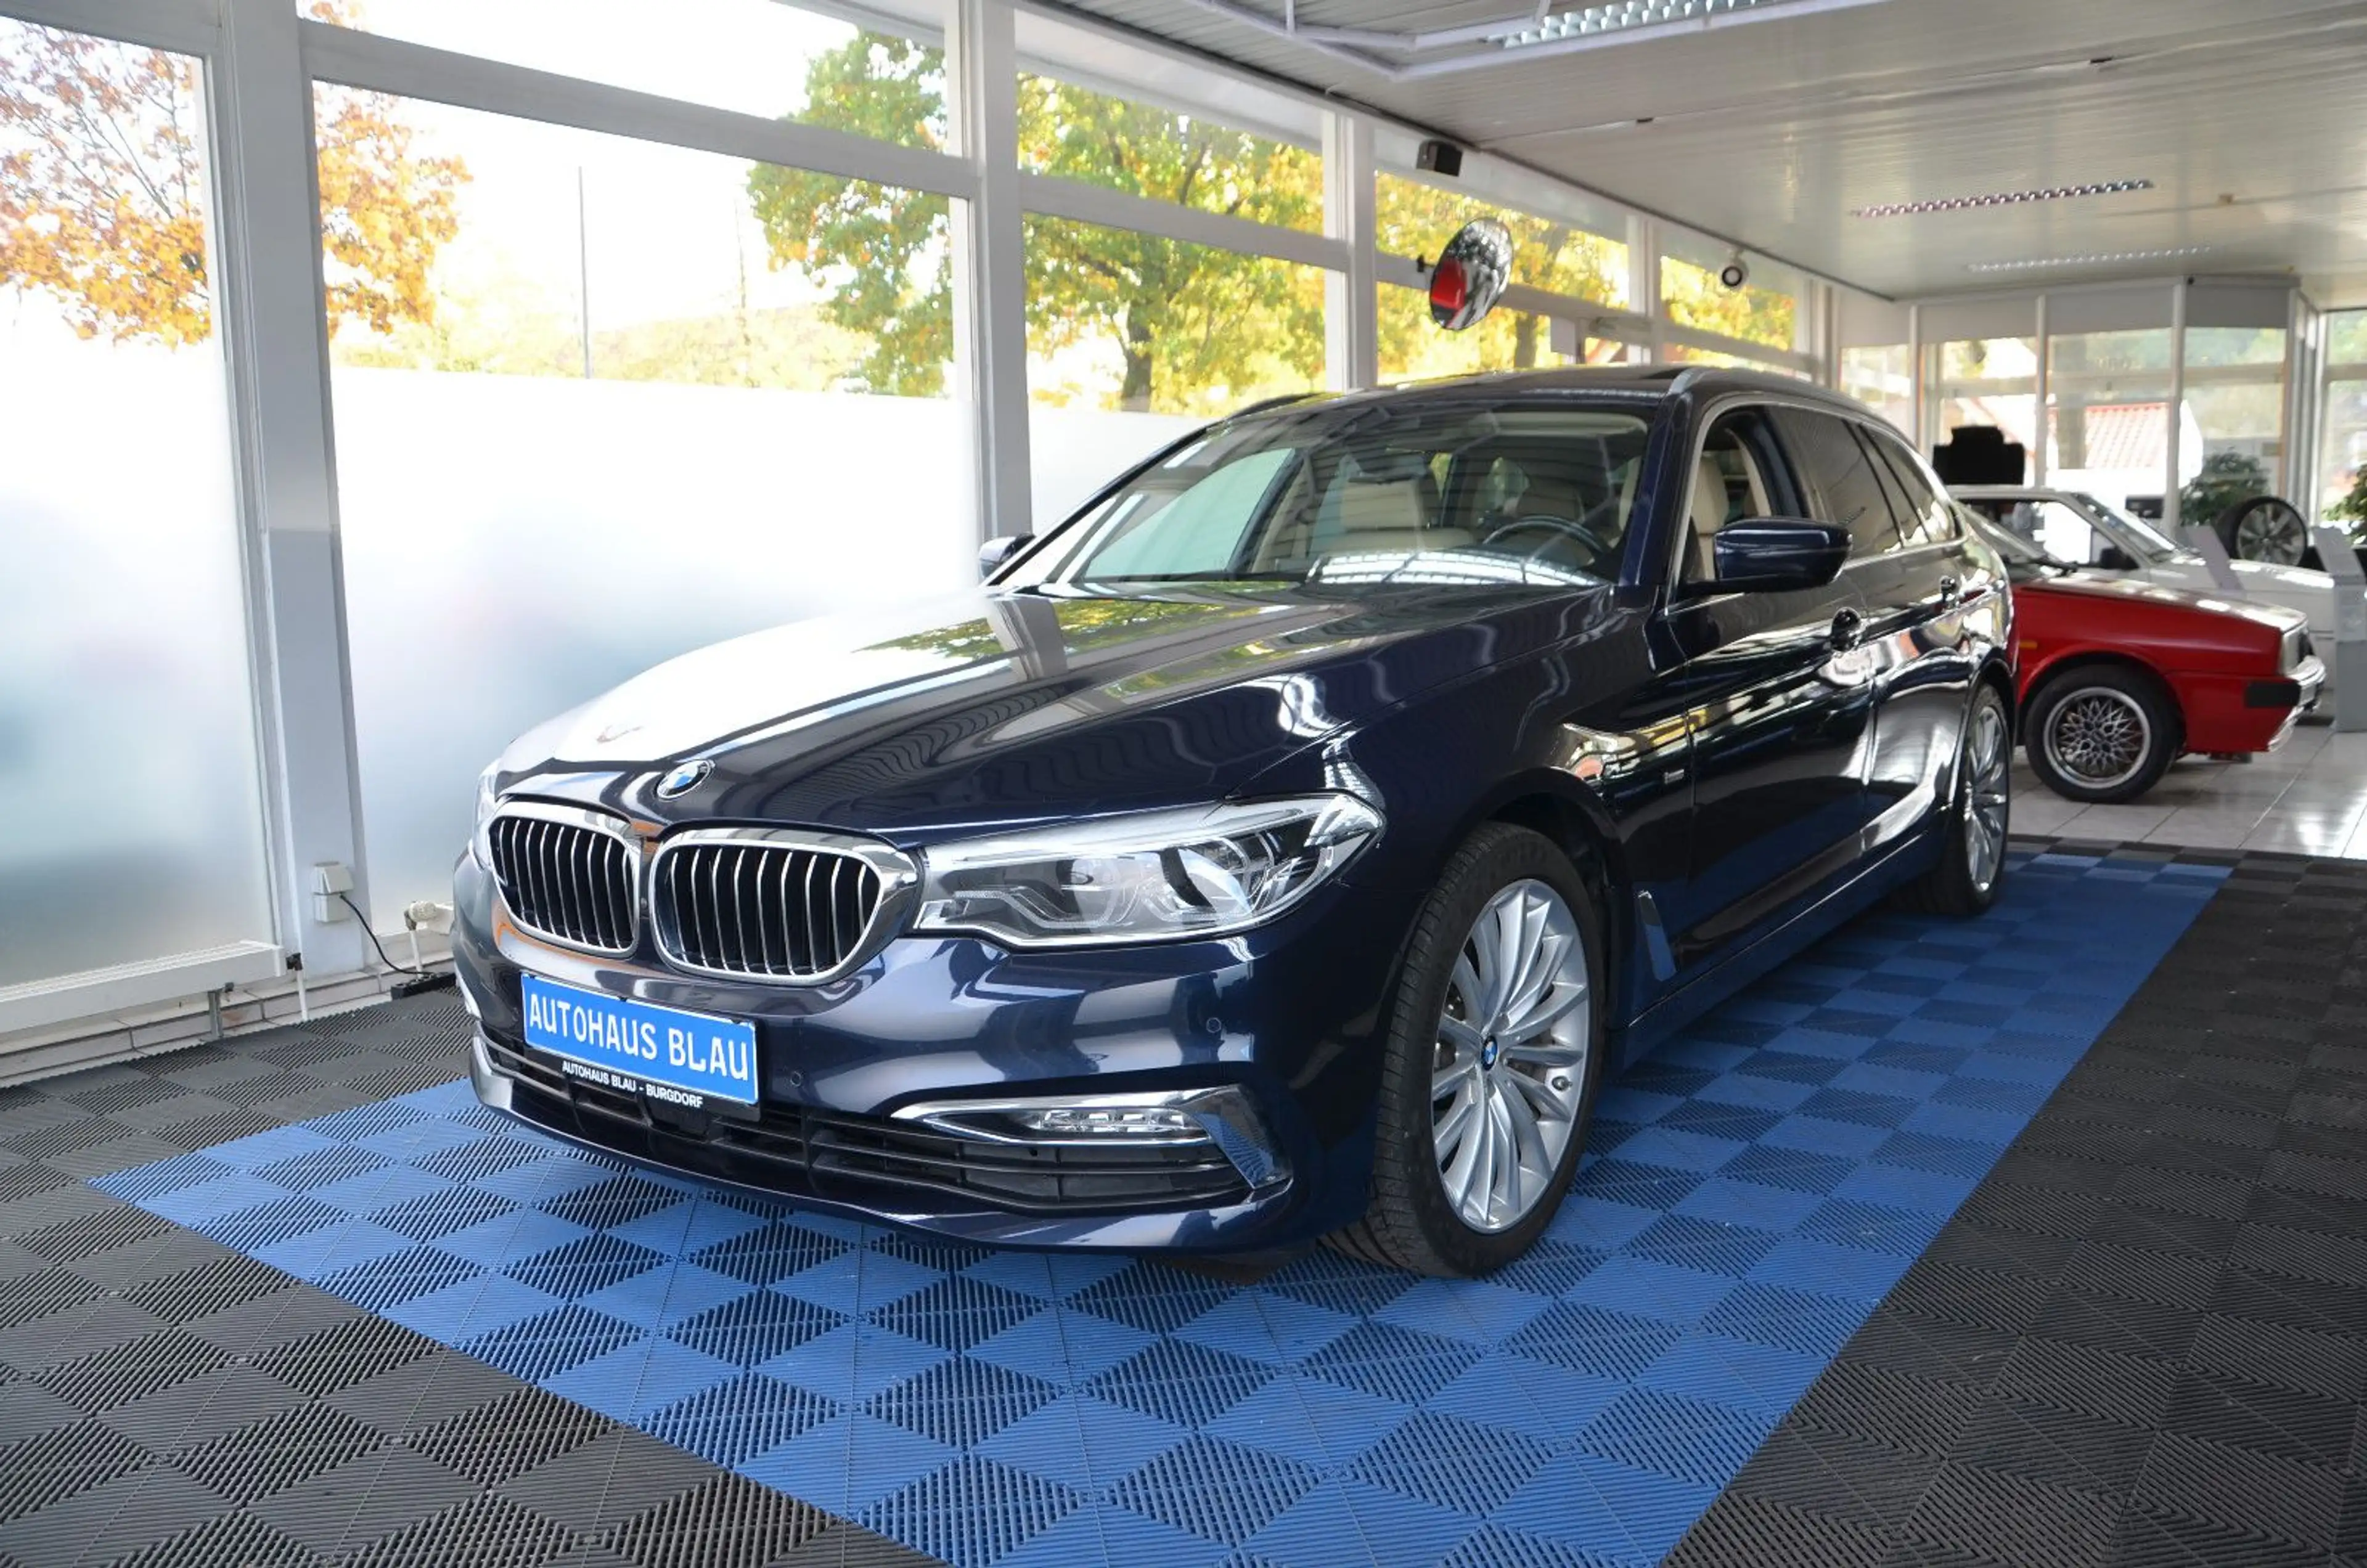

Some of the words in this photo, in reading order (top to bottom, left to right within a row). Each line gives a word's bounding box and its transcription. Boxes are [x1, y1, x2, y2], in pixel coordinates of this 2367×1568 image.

[529, 993, 657, 1060] AUTOHAUS
[668, 1027, 748, 1081] BLAU
[562, 1060, 609, 1085] AUTOHAUS
[611, 1074, 636, 1093] BLAU
[645, 1083, 704, 1108] BURGDORF
